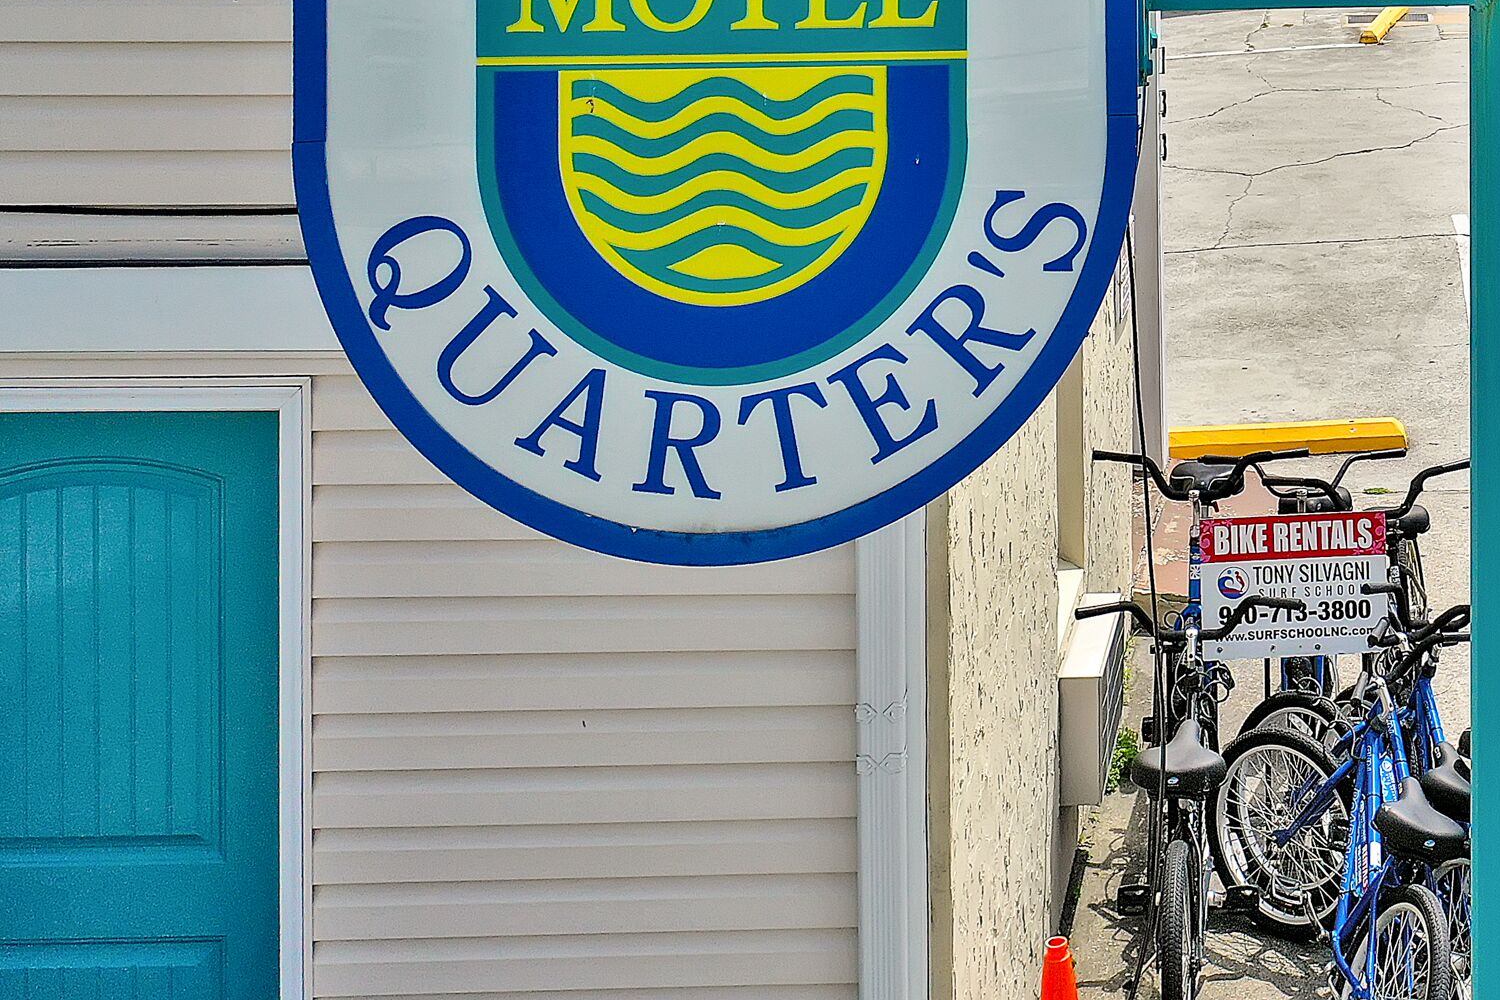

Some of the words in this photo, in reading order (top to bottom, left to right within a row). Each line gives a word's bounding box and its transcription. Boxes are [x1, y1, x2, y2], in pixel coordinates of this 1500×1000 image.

[367, 189, 1087, 500] QUARTER'S
[1213, 523, 1268, 556] BIKE
[1273, 518, 1374, 553] RENTALS
[1252, 564, 1295, 585] TONY
[1299, 561, 1370, 583] SILVAGNI
